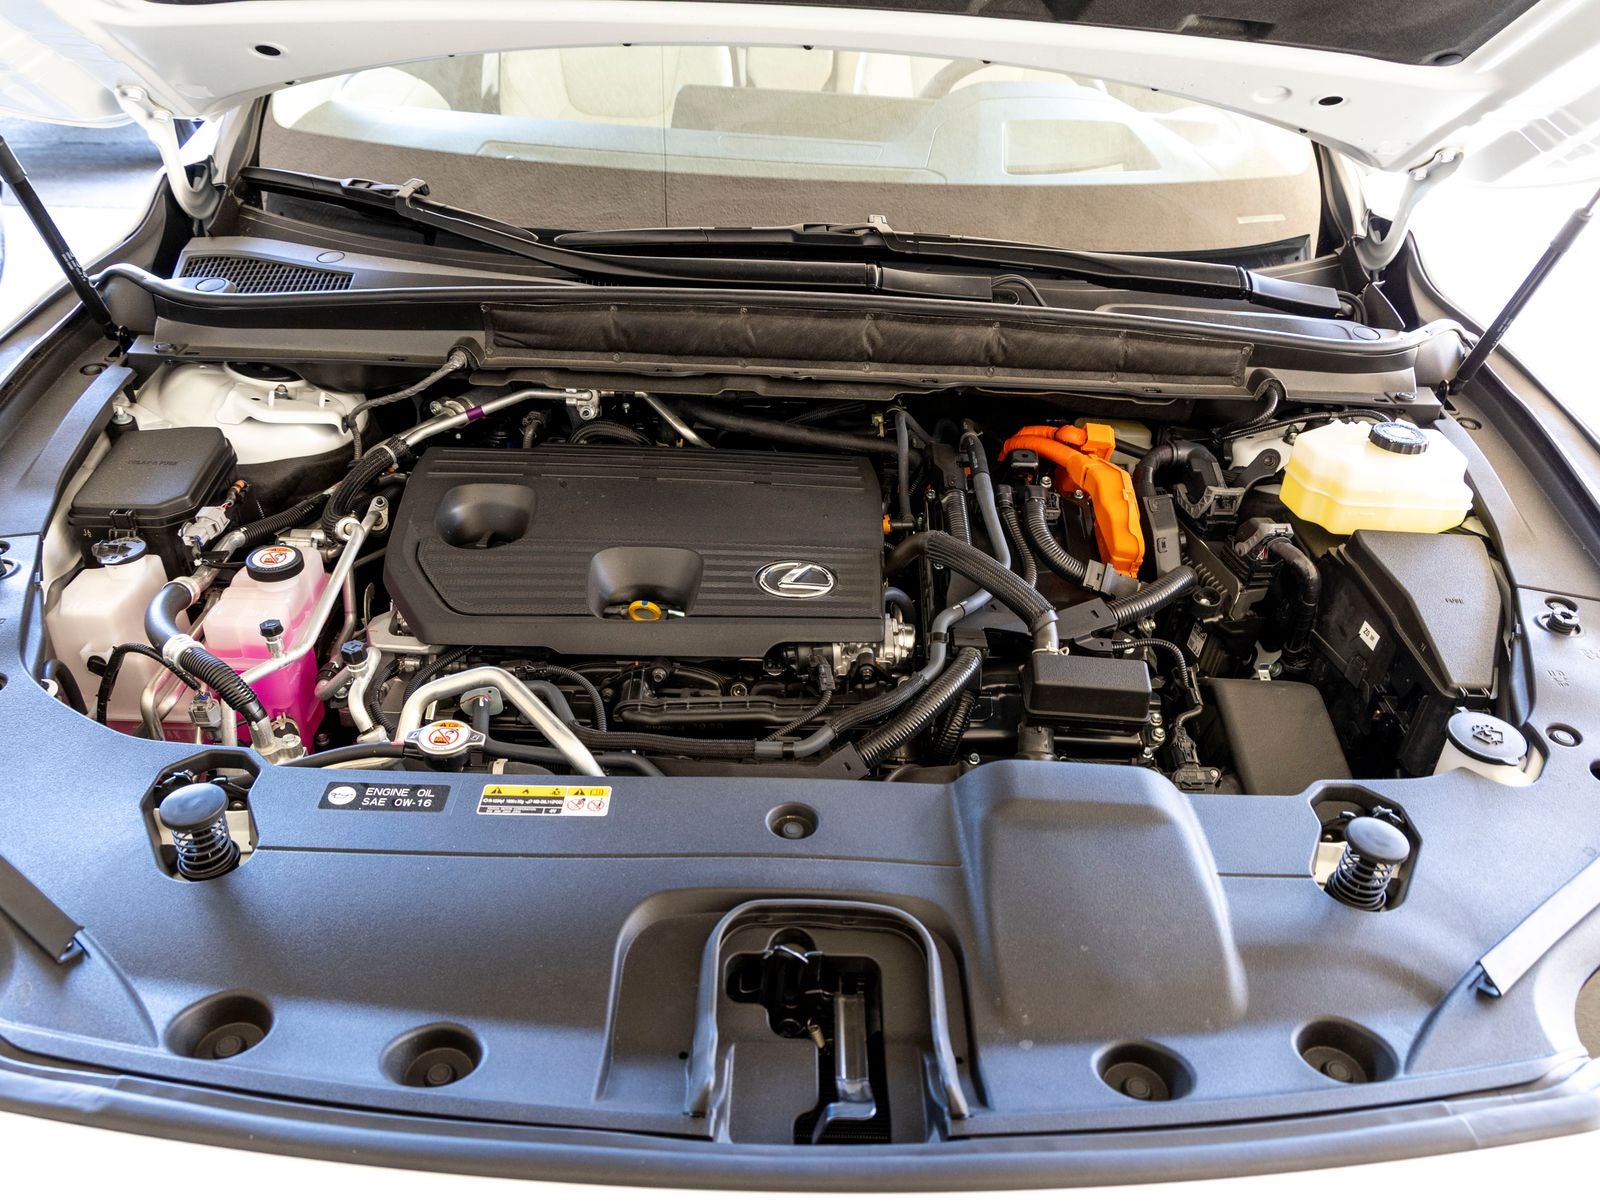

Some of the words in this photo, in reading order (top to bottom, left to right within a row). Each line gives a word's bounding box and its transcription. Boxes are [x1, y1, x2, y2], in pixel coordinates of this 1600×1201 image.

[365, 787, 410, 797] ENGINE
[416, 789, 435, 798] OIL
[361, 797, 387, 806] SAE
[394, 799, 433, 807] 0W-16
